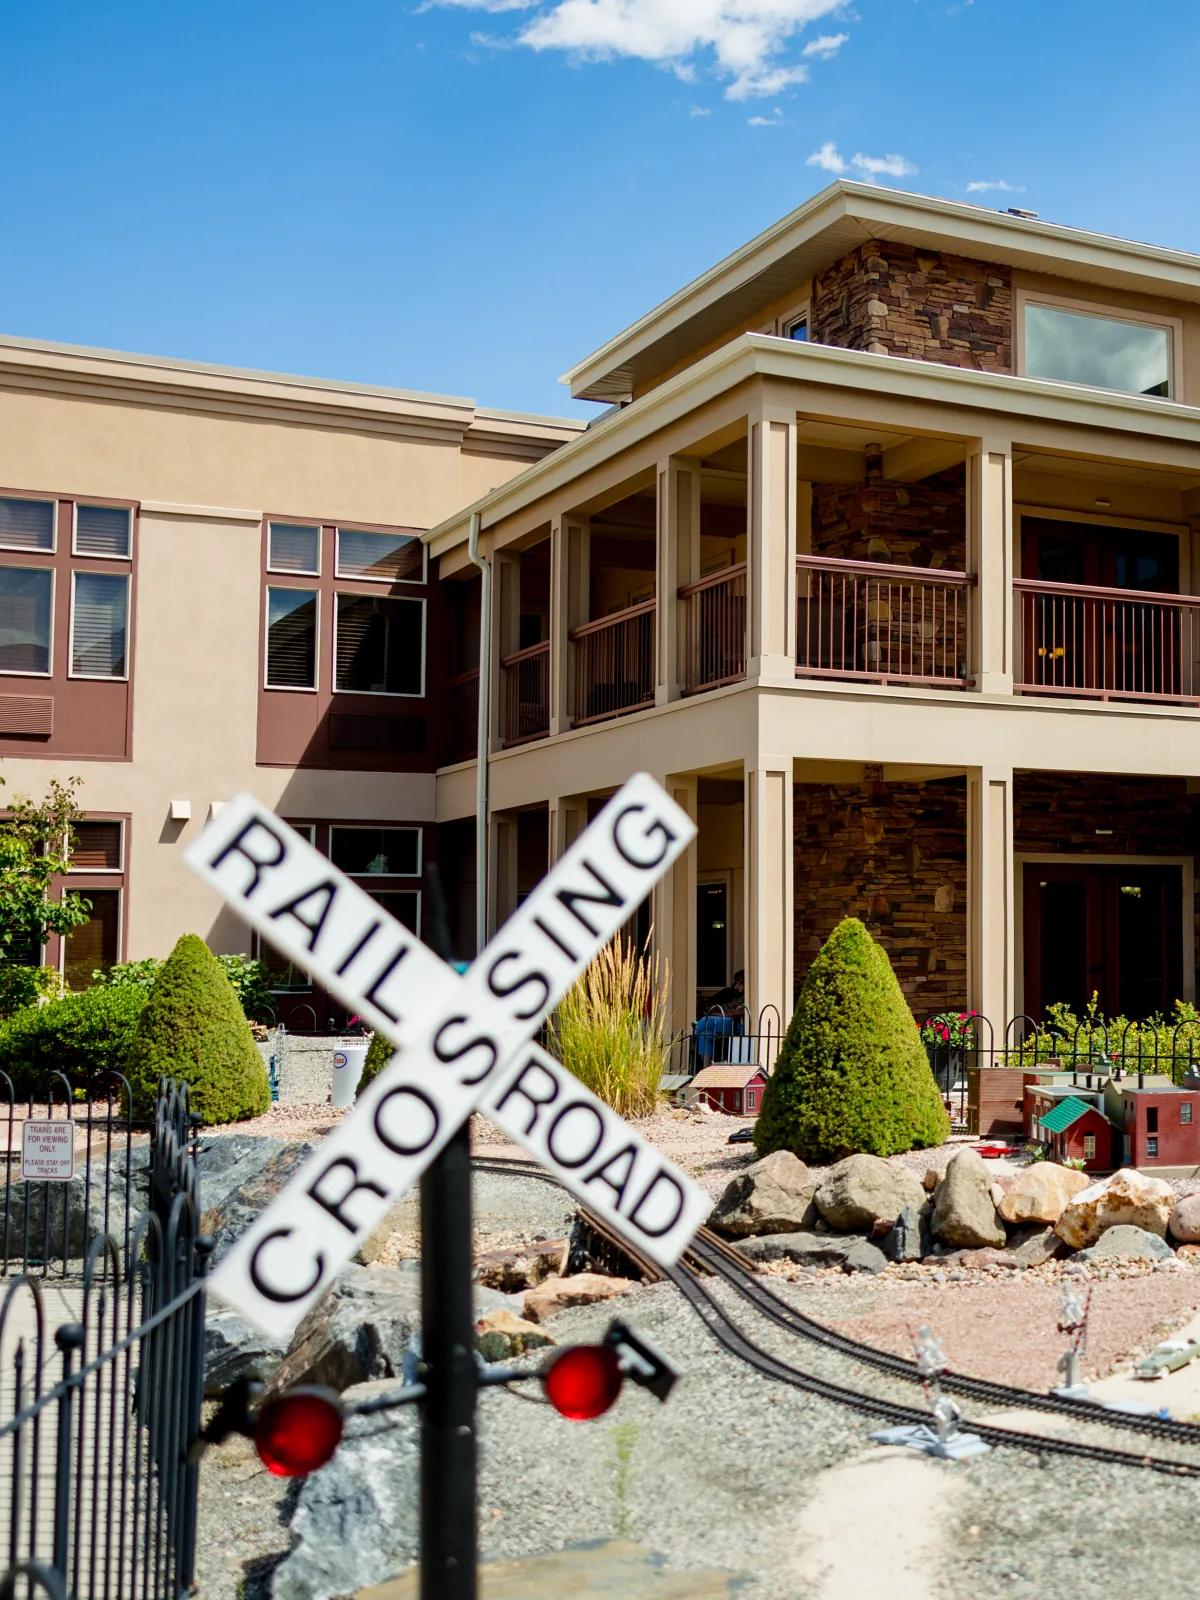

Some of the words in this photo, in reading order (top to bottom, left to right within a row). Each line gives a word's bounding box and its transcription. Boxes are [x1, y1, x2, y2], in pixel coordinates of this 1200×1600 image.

[210, 813, 412, 1024] RAIL
[493, 1056, 685, 1239] ROAD
[249, 804, 677, 1302] CROSSING
[30, 1126, 52, 1134] TRAINS
[28, 1135, 41, 1143] FOR
[39, 1144, 57, 1152] ONLY.
